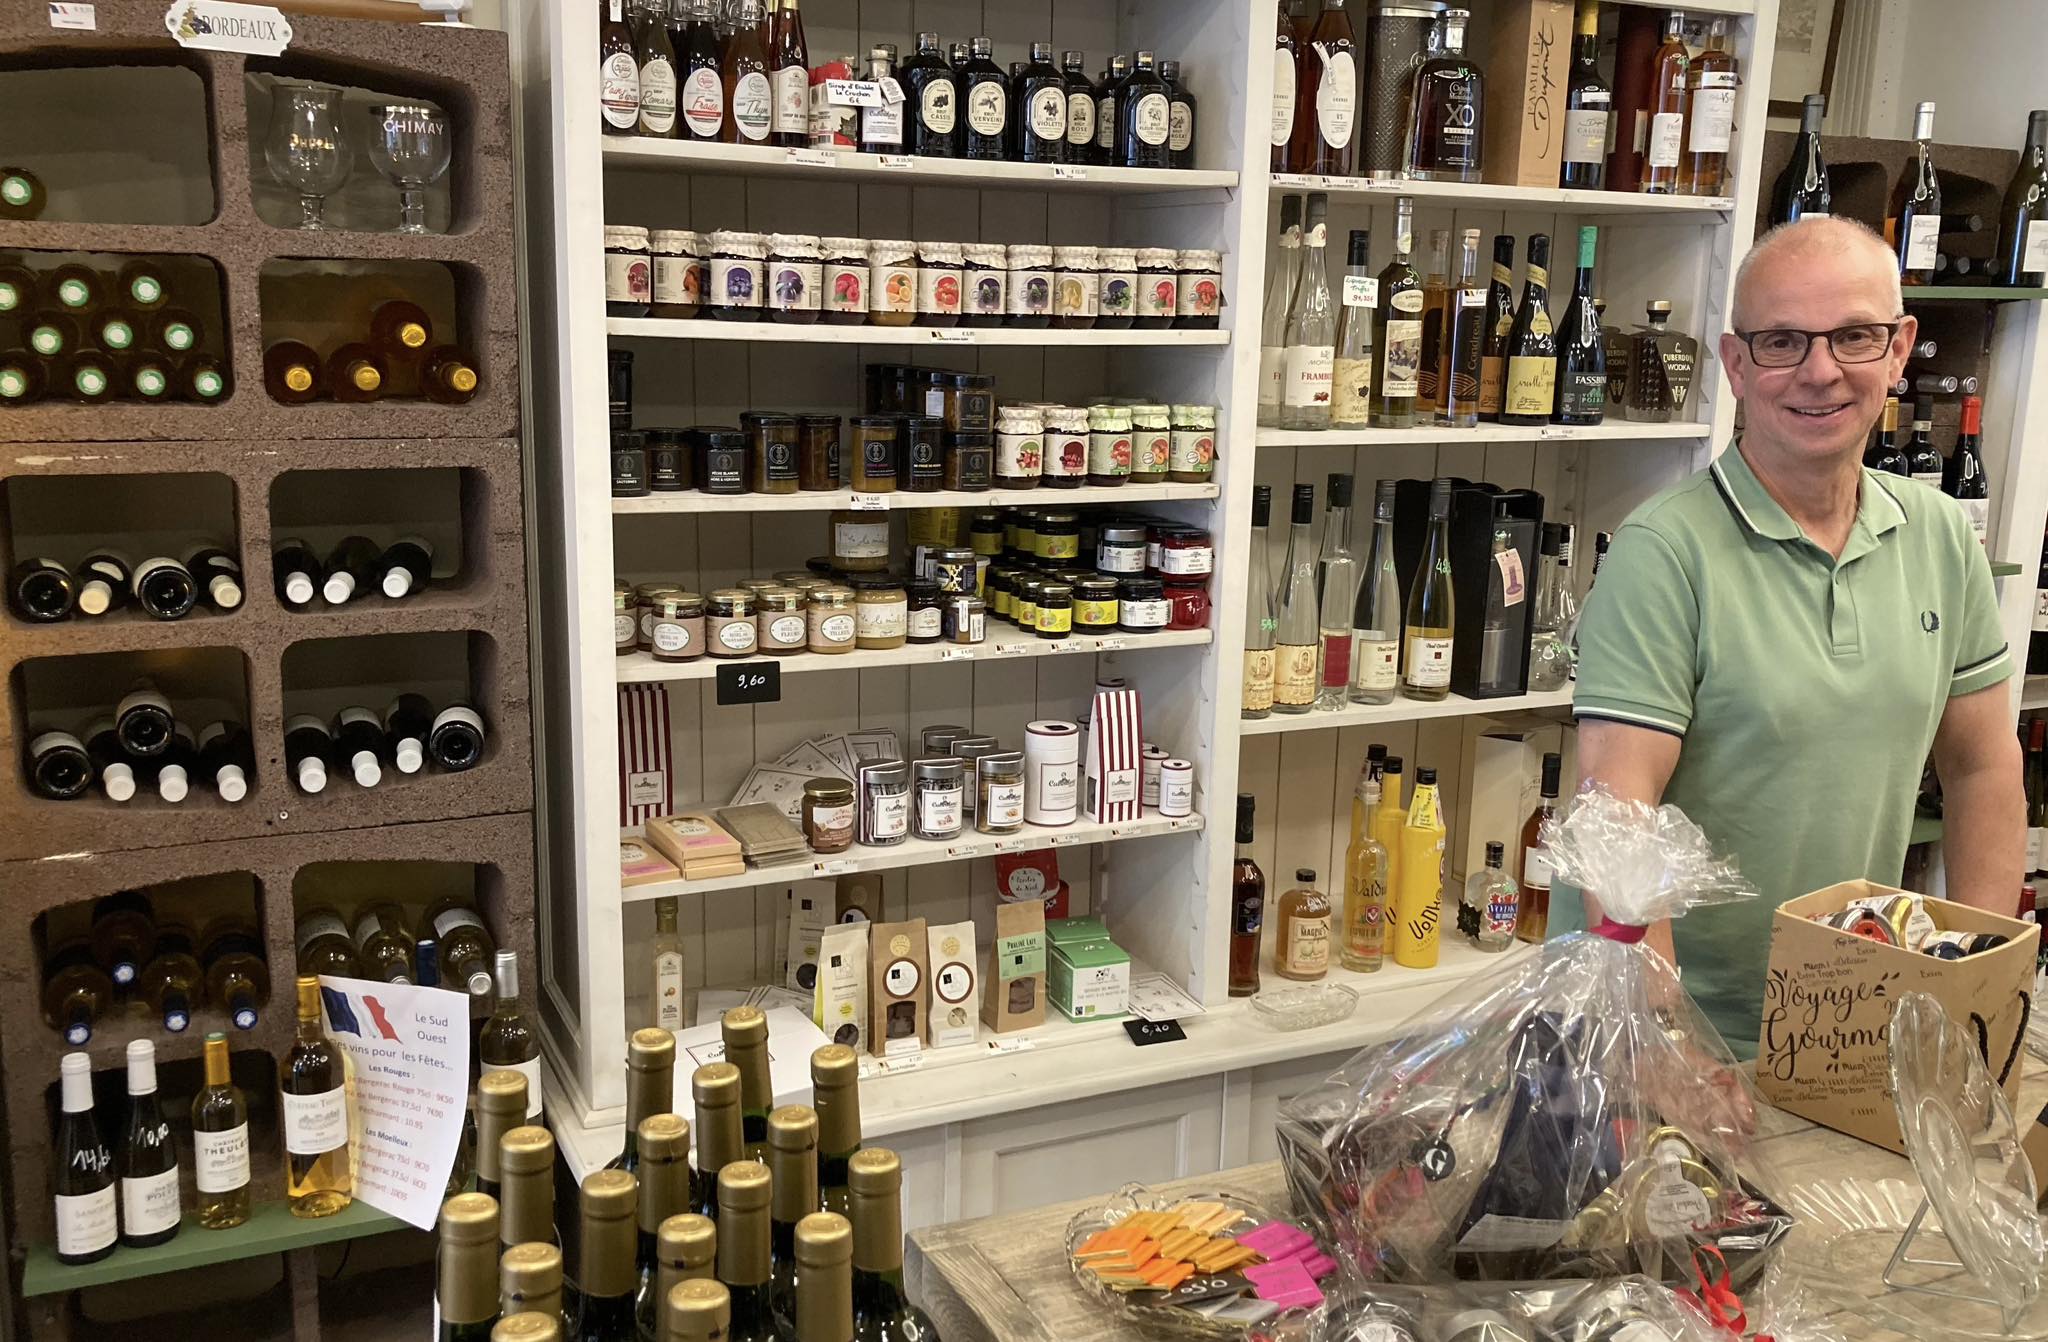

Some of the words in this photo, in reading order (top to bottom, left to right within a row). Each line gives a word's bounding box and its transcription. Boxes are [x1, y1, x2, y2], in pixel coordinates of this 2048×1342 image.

[202, 15, 277, 41] BORDEAUX
[1444, 103, 1475, 127] XO
[382, 119, 444, 136] CHIMAY
[1667, 363, 1691, 371] WODKA
[737, 673, 766, 690] 9,60
[1817, 970, 1835, 979] Trop
[1835, 967, 1854, 976] bon
[1766, 978, 1873, 1026] Voyage
[415, 1012, 427, 1023] Le
[429, 1016, 449, 1027] Sud
[417, 1030, 447, 1044] Ouest
[349, 1043, 370, 1056] vins
[372, 1047, 396, 1059] pour
[401, 1051, 417, 1062] les
[368, 1064, 382, 1073] Les
[383, 1066, 411, 1079] Rouges
[1848, 1085, 1866, 1094] bon
[365, 1127, 377, 1138] Les
[377, 1130, 409, 1147] Moelleux
